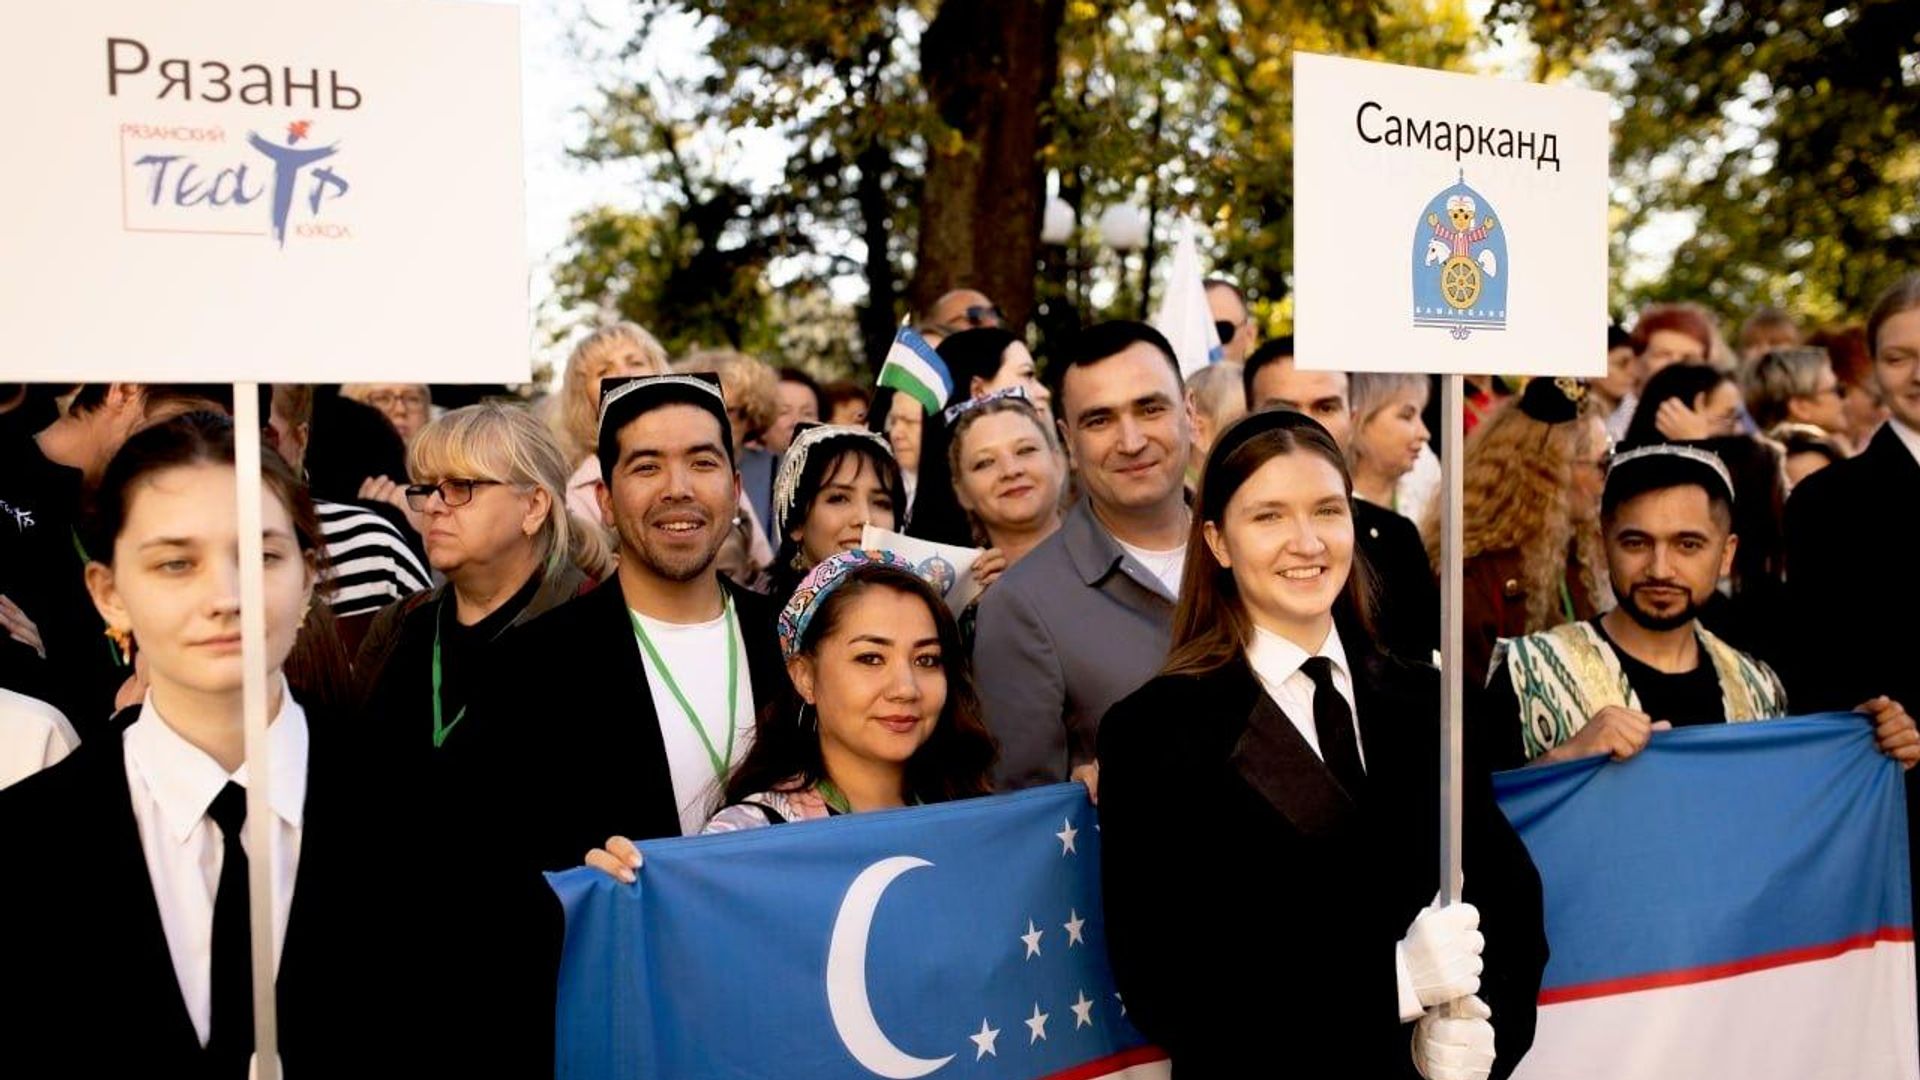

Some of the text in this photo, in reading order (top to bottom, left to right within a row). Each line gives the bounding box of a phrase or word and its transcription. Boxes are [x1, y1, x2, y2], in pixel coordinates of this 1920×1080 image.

[106, 37, 363, 111] Рязань
[120, 123, 227, 143] РЯЗАНСКИЙ
[1356, 101, 1561, 173] Самарканд
[295, 223, 352, 239] КУКОЛ
